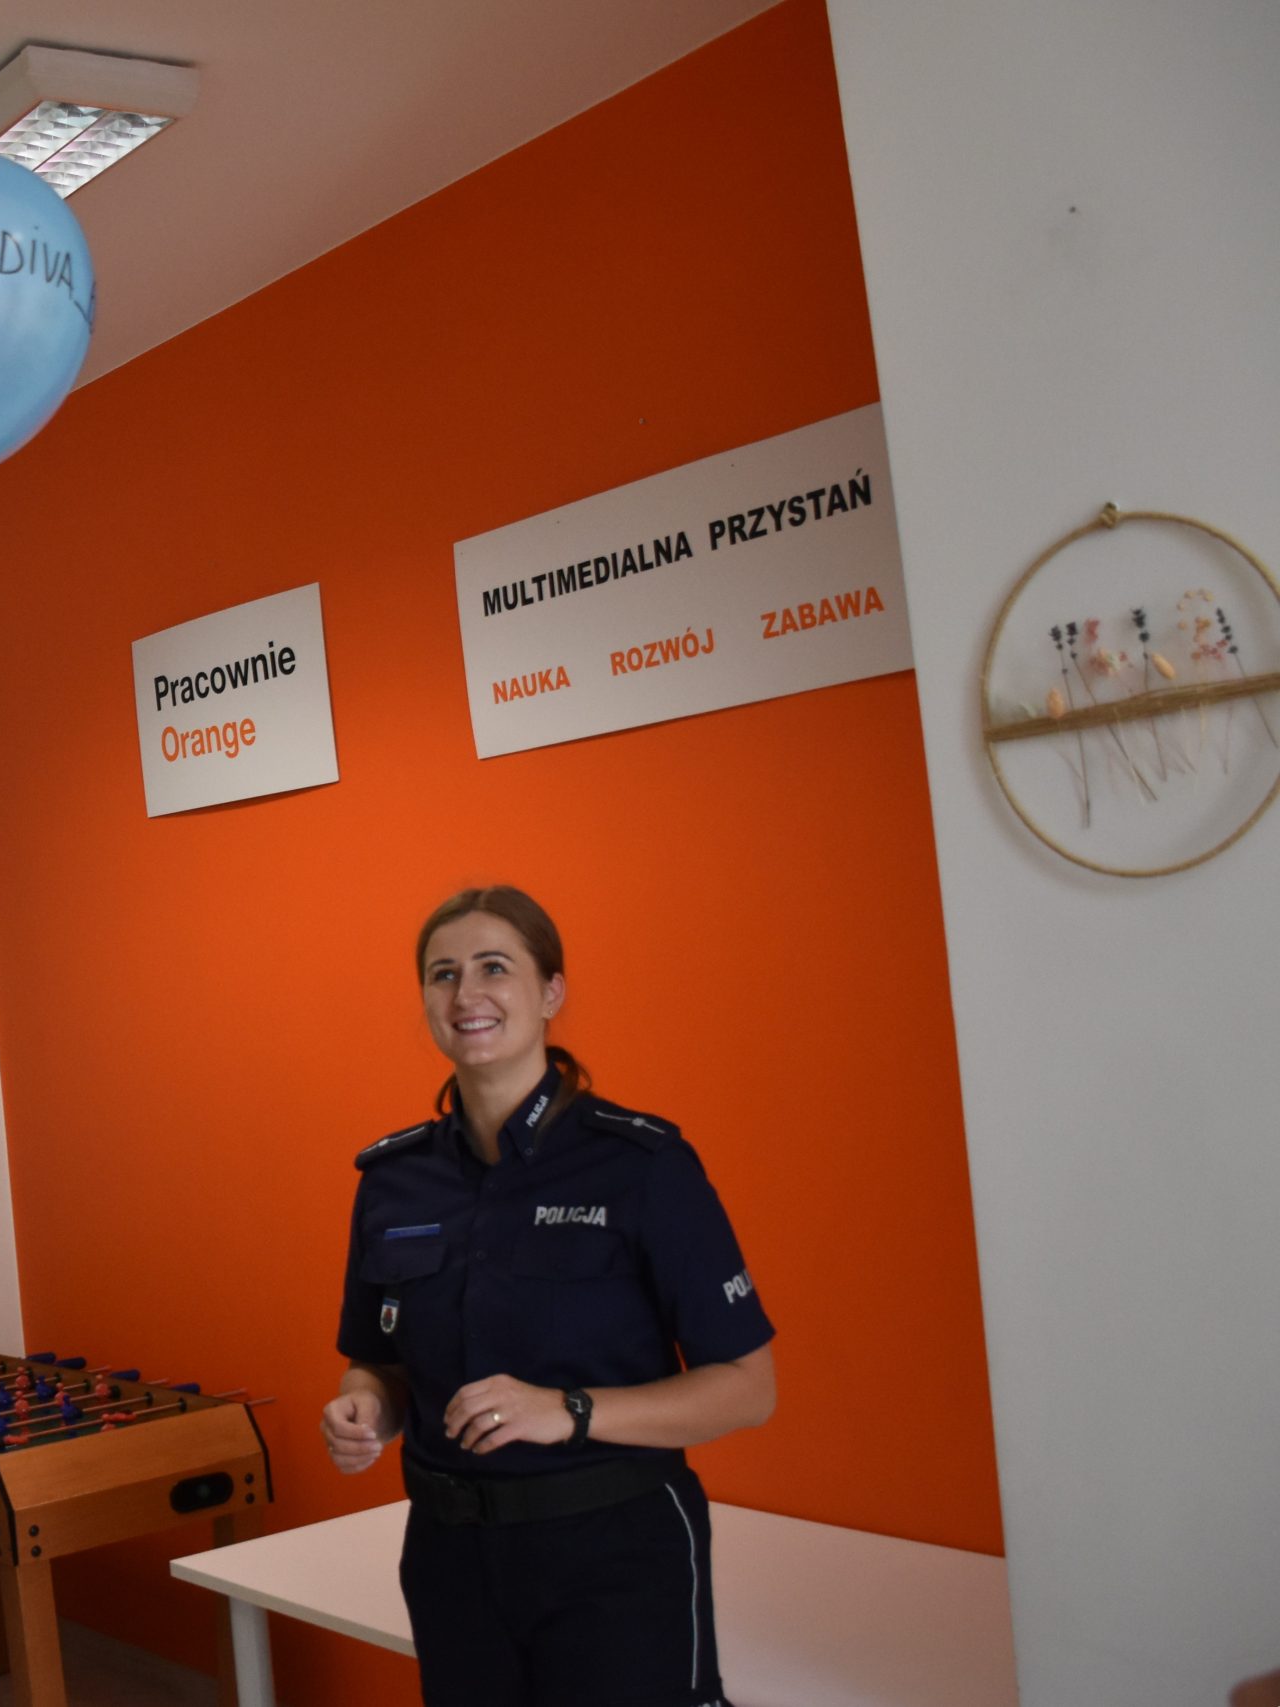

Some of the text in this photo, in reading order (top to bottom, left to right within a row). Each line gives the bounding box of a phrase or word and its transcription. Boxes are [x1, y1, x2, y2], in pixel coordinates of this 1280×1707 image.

[482, 468, 873, 616] MULTIMEDIALNA PRZYSTAŃ
[492, 586, 884, 704] NAUKA ROZWÓJ ZABAWA
[154, 640, 296, 711] Pracownie
[161, 718, 256, 763] Orange
[526, 1095, 548, 1127] POLICJA
[534, 1206, 606, 1226] POLICJA
